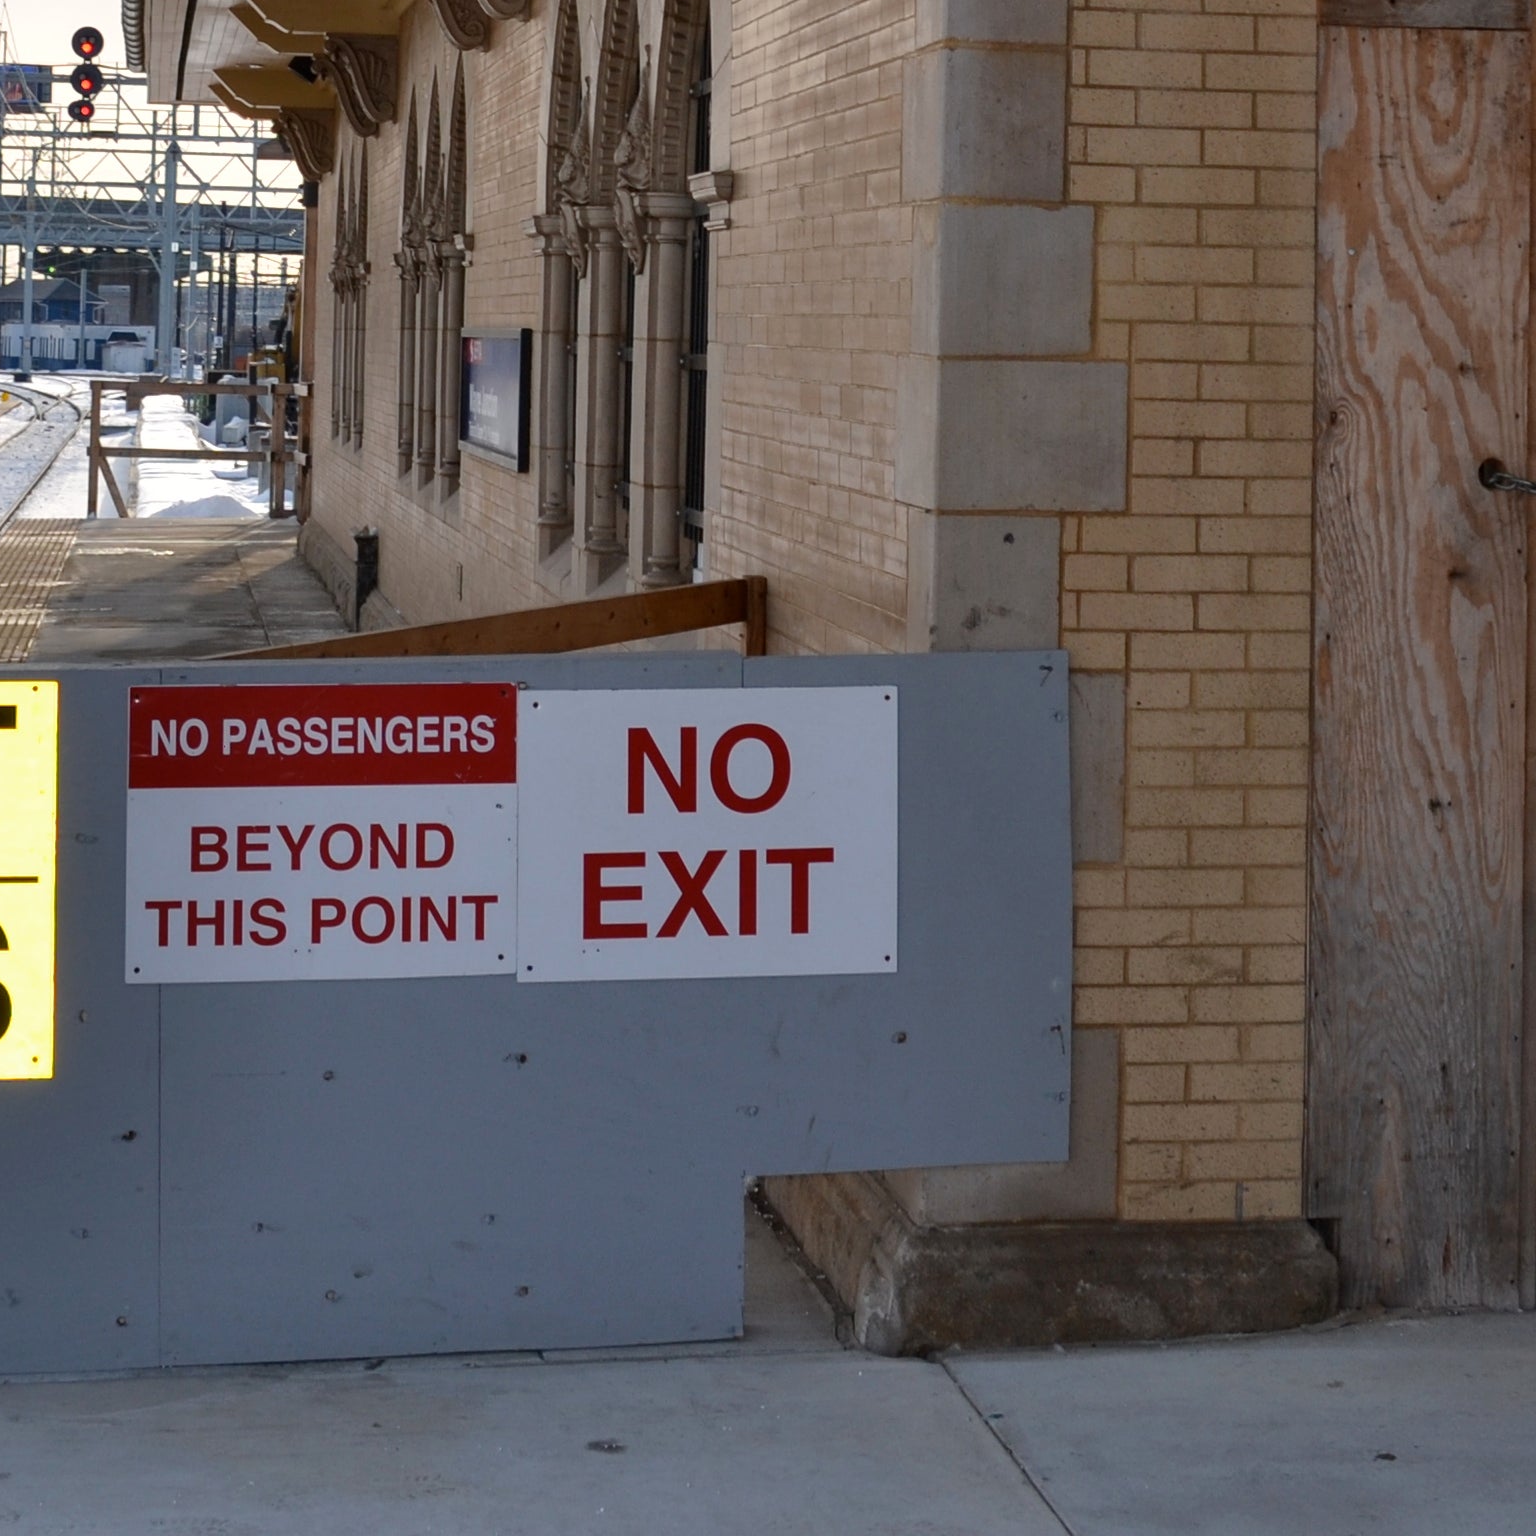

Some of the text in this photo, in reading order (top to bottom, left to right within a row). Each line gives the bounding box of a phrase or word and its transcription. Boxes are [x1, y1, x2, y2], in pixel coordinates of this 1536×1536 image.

[151, 716, 496, 757] NO PASSENGERS
[627, 723, 792, 815] NO
[190, 823, 455, 873] BEYOND
[145, 894, 498, 947] THIS POINT
[582, 847, 835, 941] EXIT
